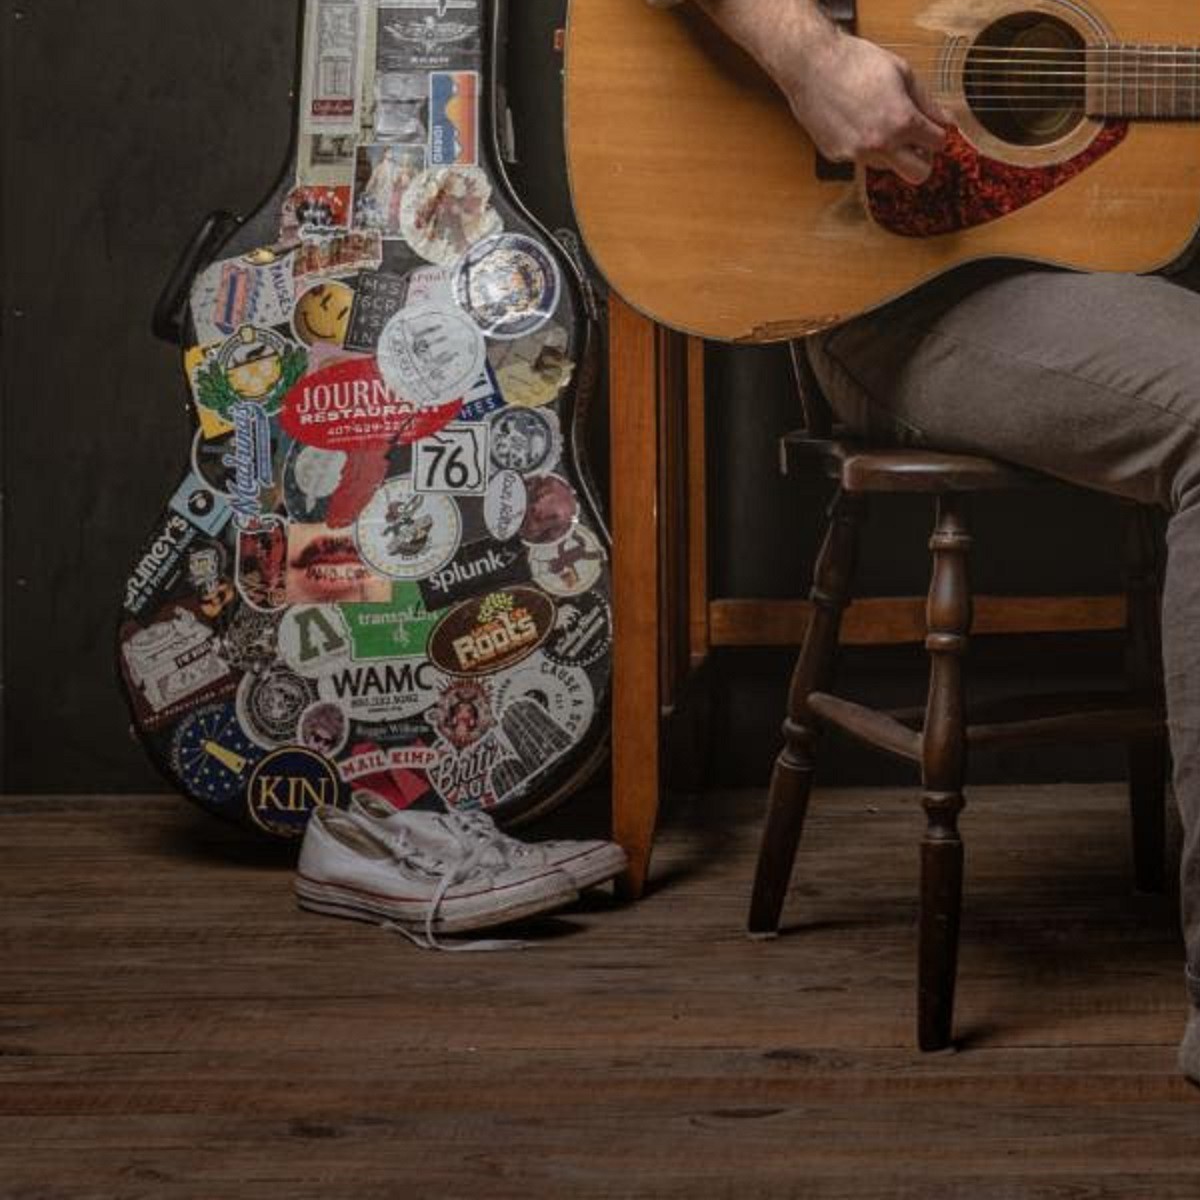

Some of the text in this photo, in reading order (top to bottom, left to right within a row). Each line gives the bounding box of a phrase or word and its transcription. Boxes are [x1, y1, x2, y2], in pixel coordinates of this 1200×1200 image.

[296, 379, 404, 413] JOURN
[422, 445, 469, 488] 76
[332, 662, 433, 698] WAMC
[540, 661, 581, 692] CAUSE
[341, 755, 385, 776] MAIL
[258, 775, 329, 812] KIN
